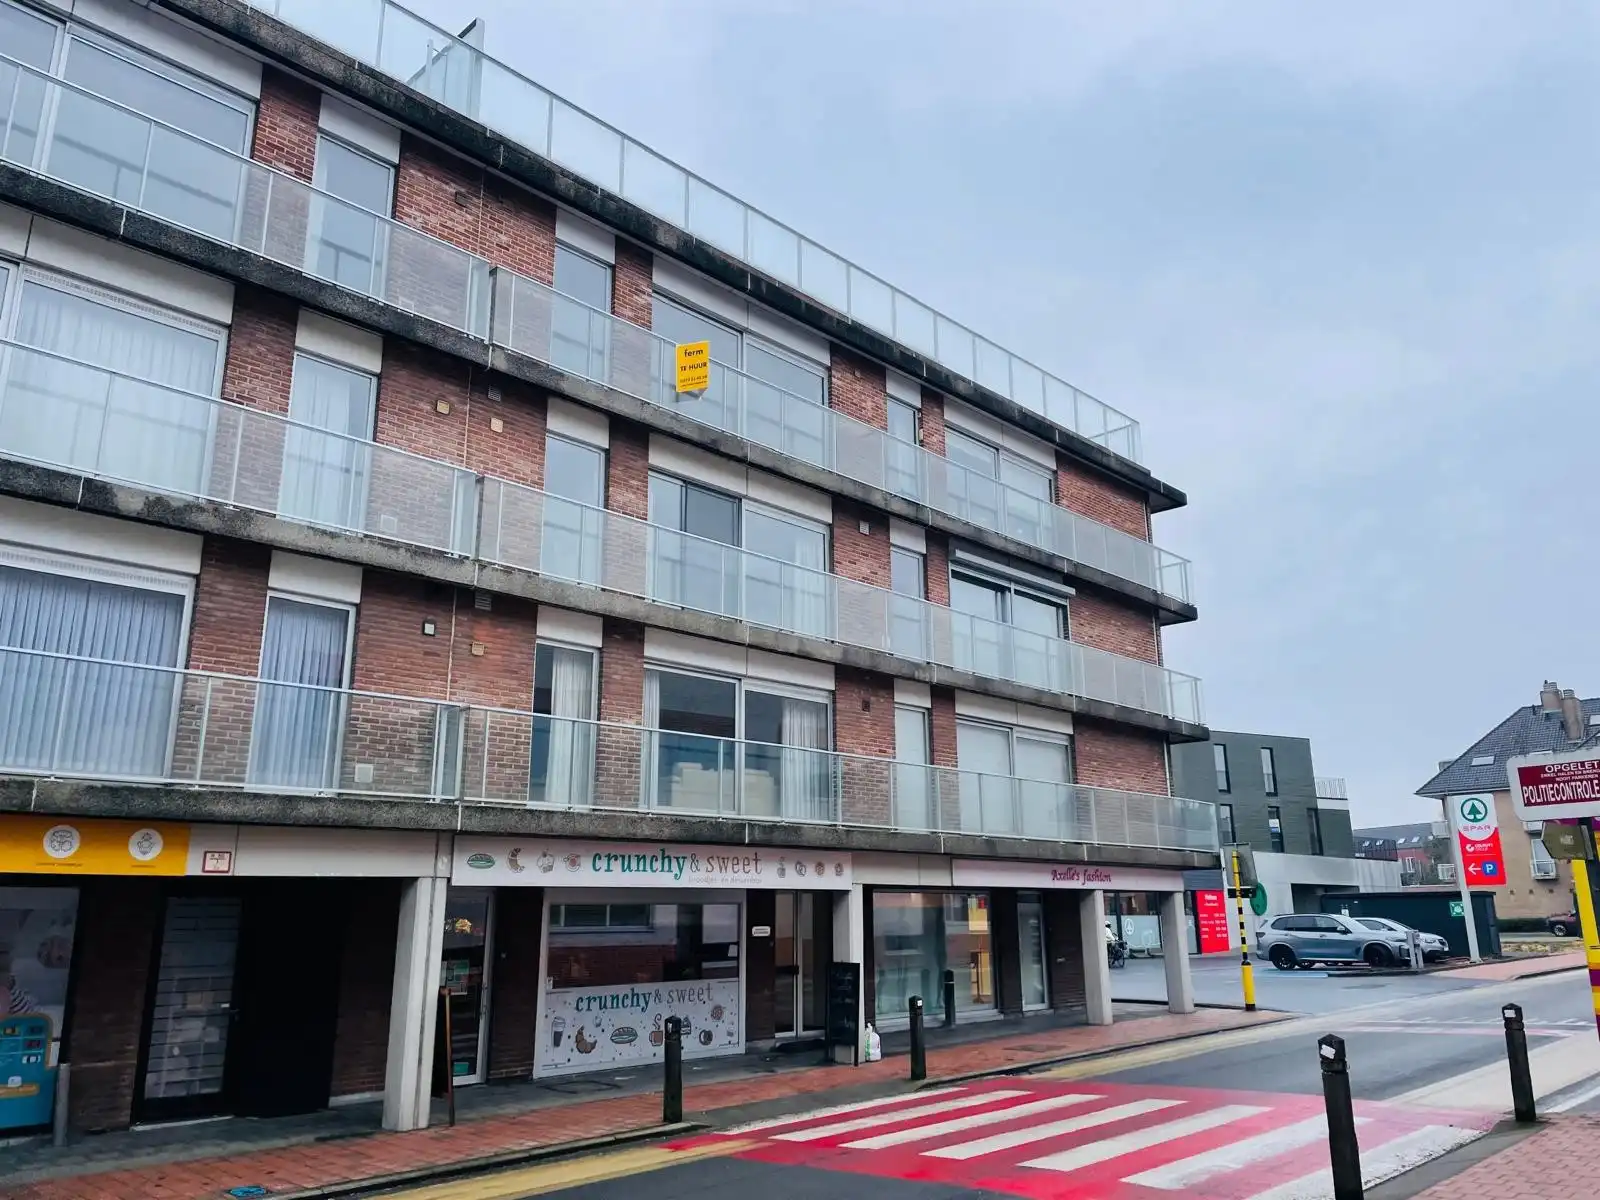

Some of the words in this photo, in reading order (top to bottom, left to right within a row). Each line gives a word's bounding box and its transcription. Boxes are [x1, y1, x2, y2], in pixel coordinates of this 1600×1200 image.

[684, 349, 703, 357] ferm
[689, 362, 707, 371] HUUR
[1545, 760, 1600, 773] OPGELET
[1523, 780, 1600, 803] POLITIECONTROLE
[592, 848, 687, 880] crunchy
[705, 852, 763, 875] sweet
[1486, 863, 1493, 873] P
[1081, 868, 1111, 885] fashion
[575, 987, 652, 1012] crunchy
[667, 983, 713, 1005] sweet
